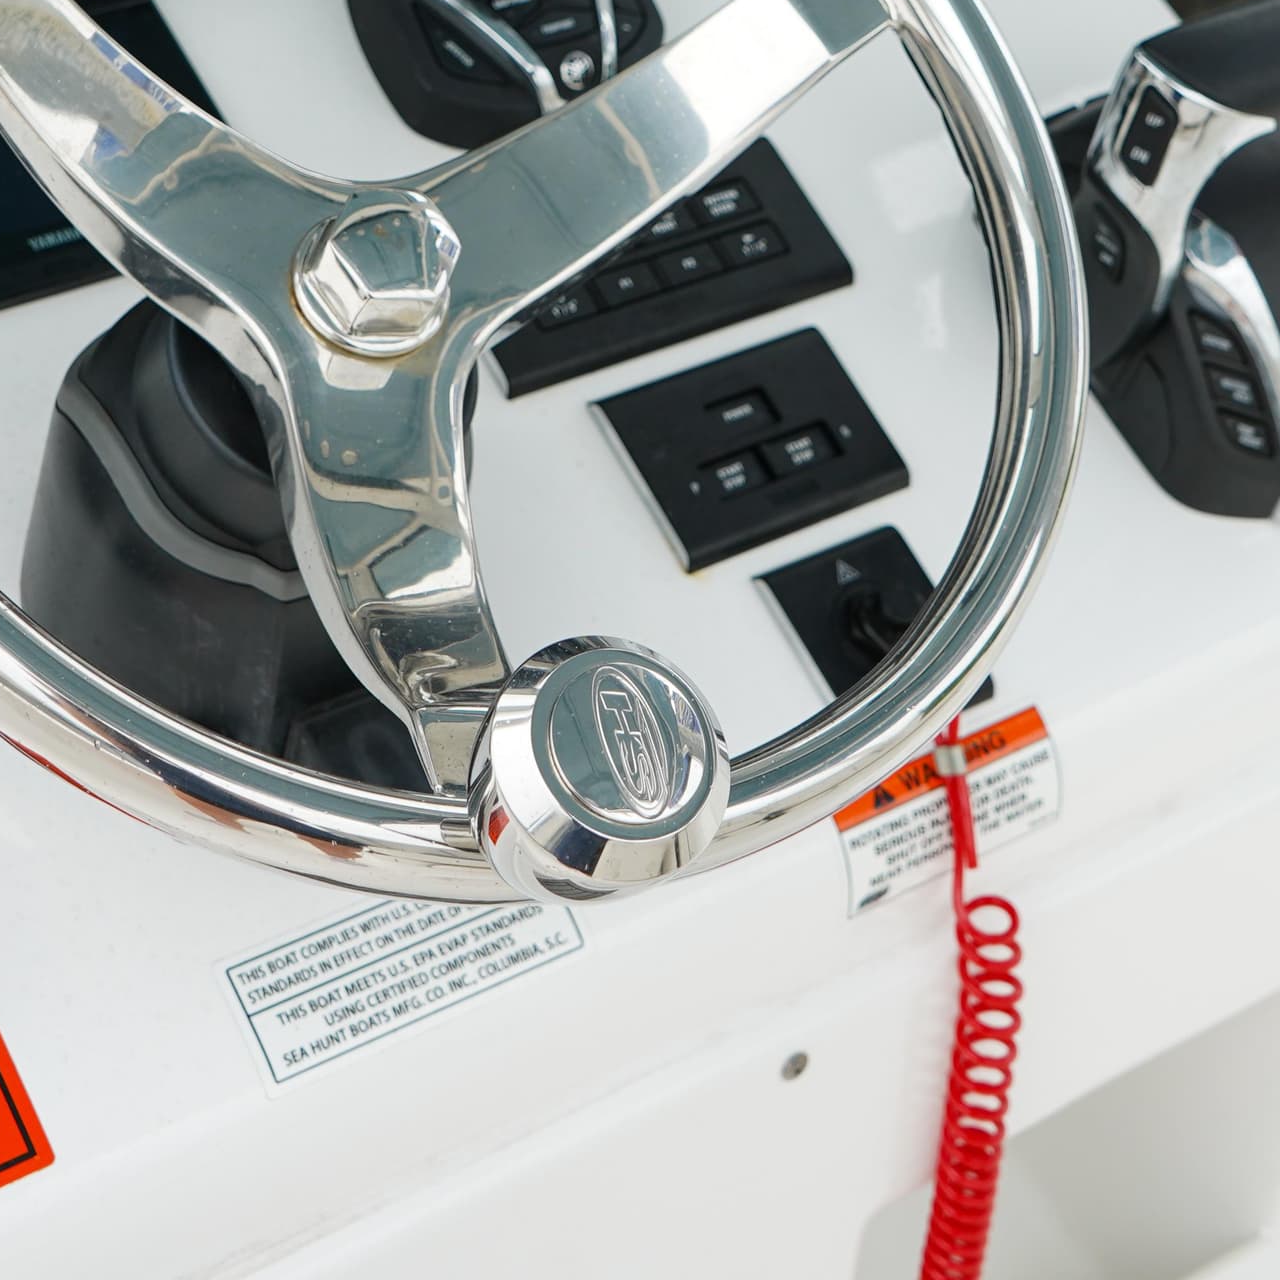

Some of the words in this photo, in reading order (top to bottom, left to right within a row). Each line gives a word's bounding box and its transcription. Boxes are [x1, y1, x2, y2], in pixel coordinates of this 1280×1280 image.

[897, 728, 1007, 793] WAING
[237, 965, 267, 985] THIS
[266, 951, 299, 975] BOAT
[300, 926, 359, 960] COMPLIES
[359, 913, 391, 934] WITH
[247, 965, 319, 1005] STANDARDS
[318, 960, 333, 973] IN
[332, 940, 374, 968] EFFECT
[375, 934, 395, 949] ON
[393, 922, 417, 940] THE
[416, 909, 447, 932] DATE
[276, 1004, 308, 1025] THIS
[307, 988, 342, 1013] BOAT
[344, 970, 387, 997] MEETS
[386, 959, 411, 978] U.S.
[412, 948, 437, 967] EPA
[440, 934, 468, 956] EVAP
[324, 999, 366, 1027] USING
[366, 972, 430, 1008] CERTIFIED
[430, 933, 515, 980] COMPONENTS
[283, 1047, 310, 1067] SEA
[309, 1028, 347, 1055] HUNT
[348, 1009, 391, 1038] BOATS
[391, 997, 423, 1017] MFG.
[424, 985, 447, 1003] CO.
[544, 931, 567, 951] S.C.
